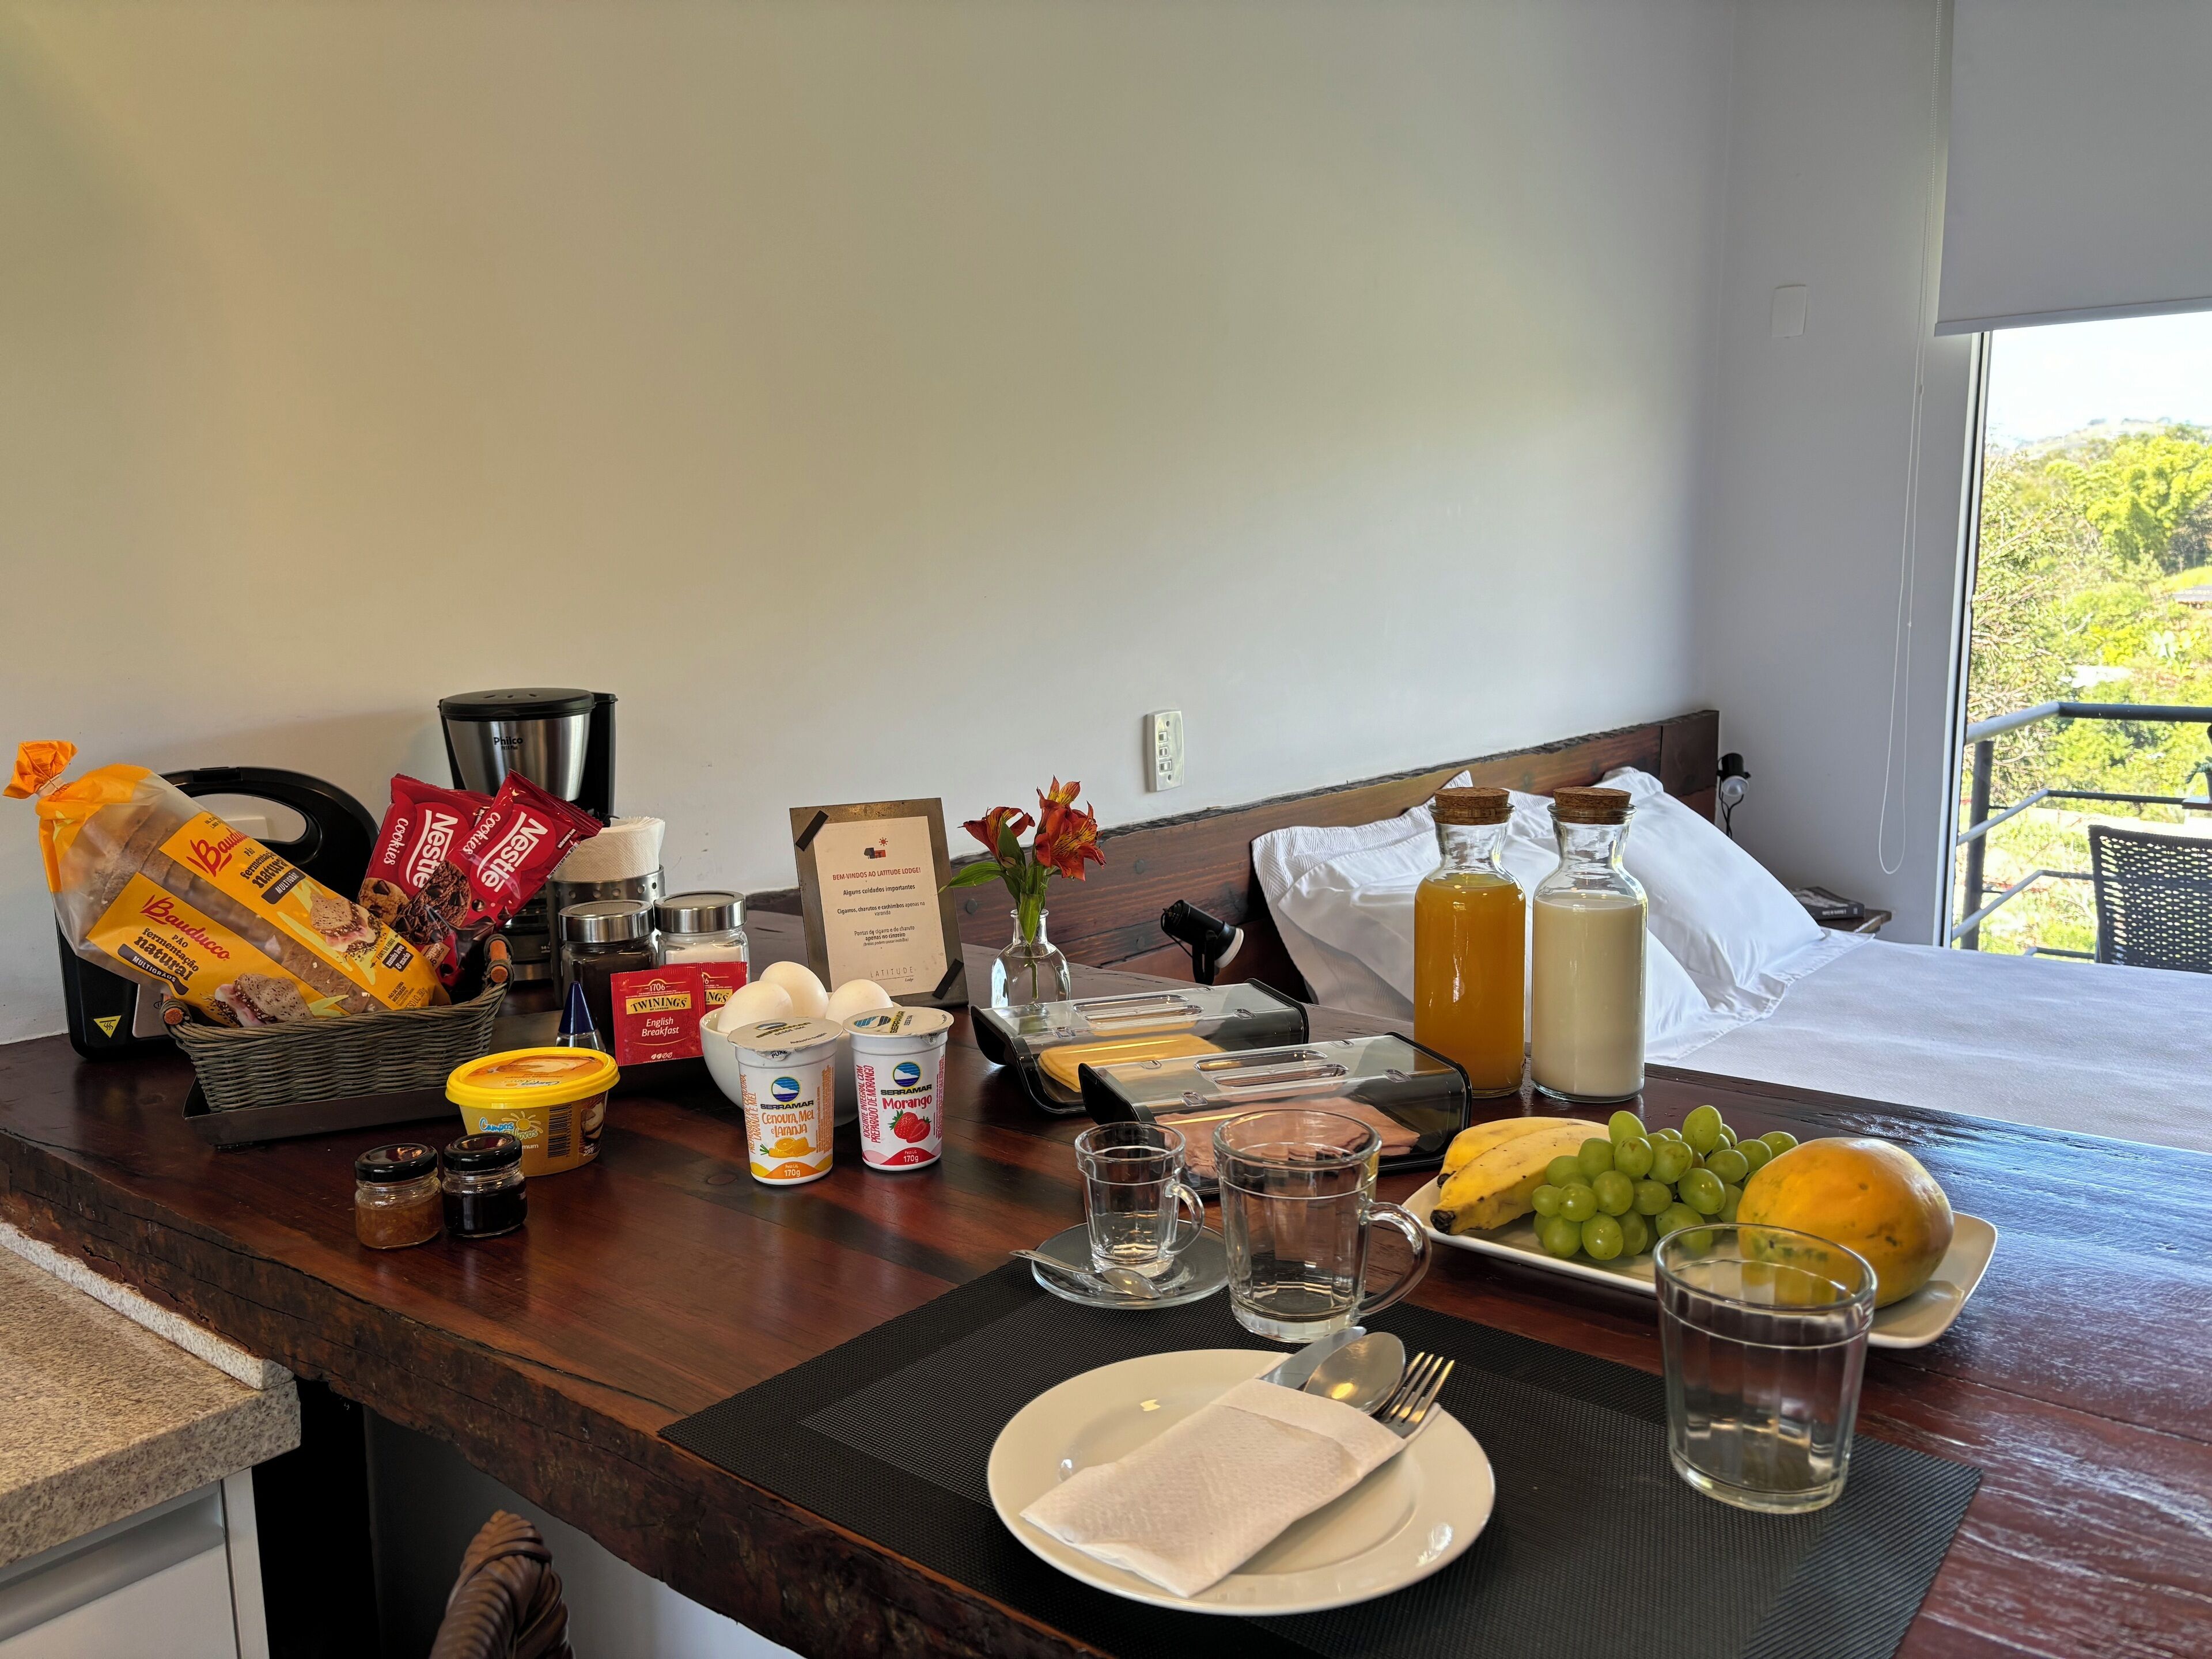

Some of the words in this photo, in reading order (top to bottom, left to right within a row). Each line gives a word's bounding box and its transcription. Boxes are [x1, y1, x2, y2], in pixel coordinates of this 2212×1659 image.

[494, 736, 523, 745] Philco
[463, 812, 501, 854] cookies
[384, 817, 409, 865] cookies
[832, 872, 867, 881] BEM-VINDOS
[877, 869, 901, 877] LATITUDE
[885, 884, 915, 893] importantes
[837, 907, 858, 915] Cigarros,
[139, 894, 230, 960] Bauducco
[172, 934, 188, 948] PÃO
[142, 928, 199, 972] fermentação
[385, 952, 399, 967] muito
[395, 944, 404, 954] leve
[134, 935, 195, 980] natural
[397, 951, 411, 965] macio
[132, 956, 176, 982] MULTIGRÃOS
[870, 967, 913, 978] LATITUDE
[650, 983, 665, 992] 1706
[631, 998, 687, 1012] TWININGS
[646, 1017, 673, 1028] English
[642, 1026, 680, 1037] Breakfast
[771, 1050, 787, 1059] PUXE
[856, 1065, 864, 1080] COM
[864, 1065, 877, 1096] MORANGO
[858, 1081, 868, 1111] INTEGRAL
[881, 1084, 932, 1095] SERRAMAR
[748, 1093, 757, 1106] MEL
[760, 1100, 814, 1110] SERRAMAR
[868, 1096, 877, 1107] DE
[882, 1094, 932, 1109] Morango
[799, 1110, 815, 1122] Mel
[479, 1117, 514, 1132] Campos
[751, 1113, 762, 1141] LARANJA
[860, 1110, 870, 1138] IOGURTE
[868, 1107, 881, 1143] PREPARADO
